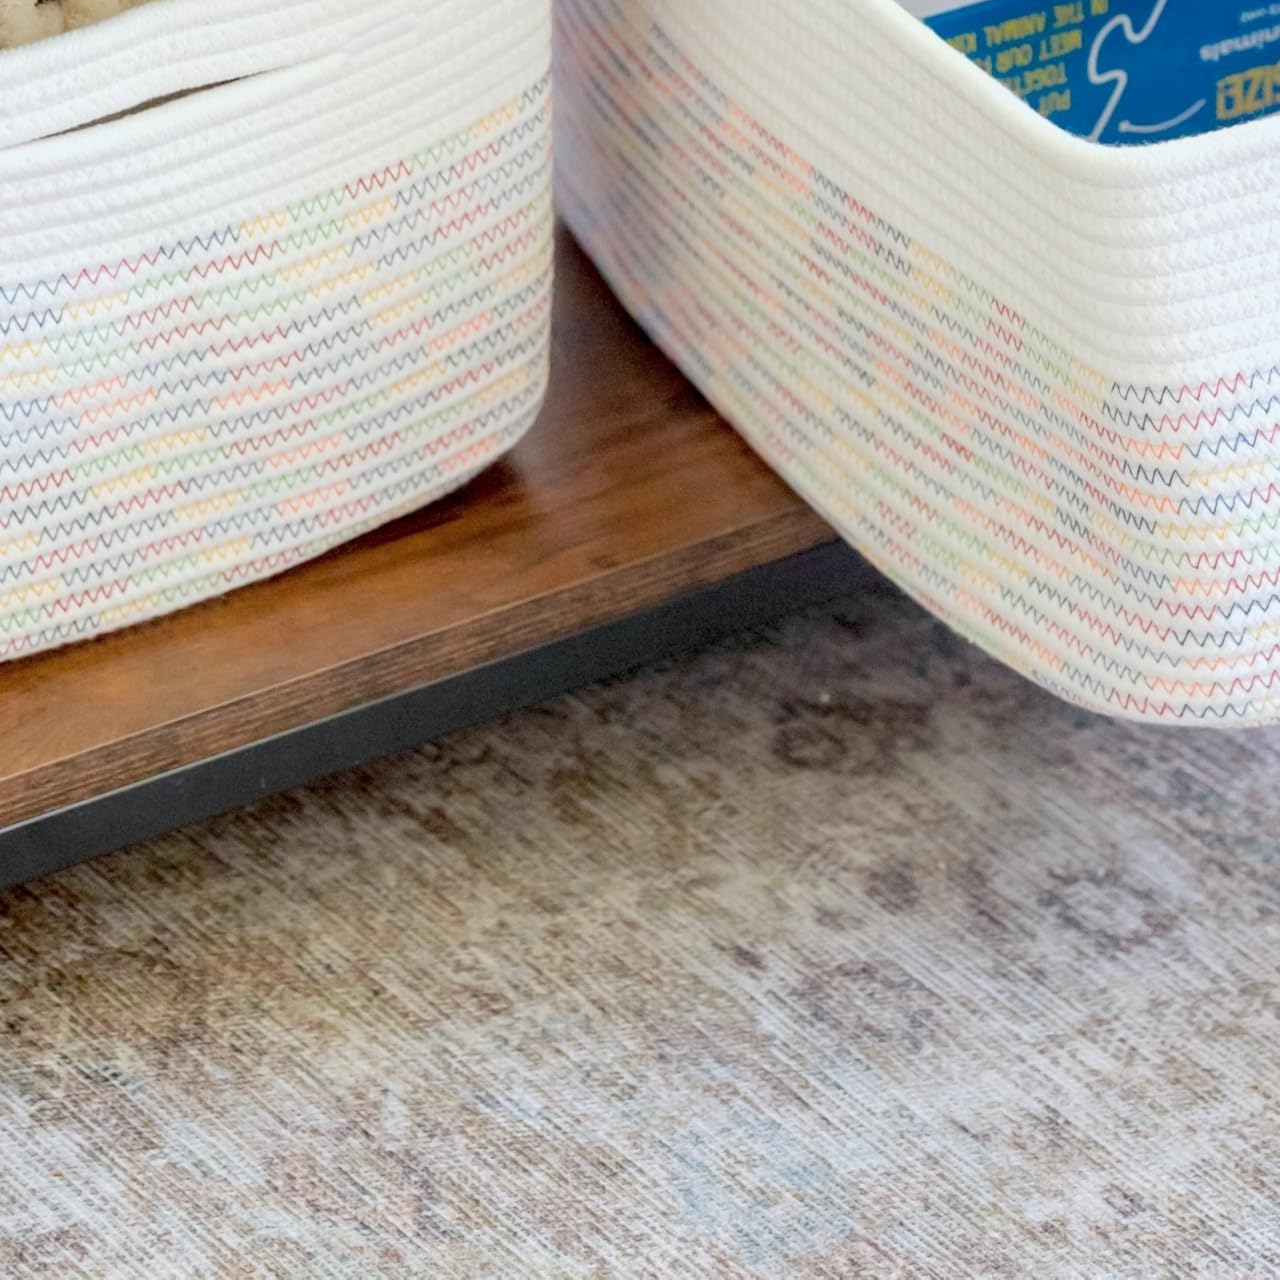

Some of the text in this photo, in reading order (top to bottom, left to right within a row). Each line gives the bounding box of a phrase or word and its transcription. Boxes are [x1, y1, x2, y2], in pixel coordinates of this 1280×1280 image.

[1053, 0, 1085, 28] THE
[983, 11, 1047, 47] ANIMAL
[996, 44, 1033, 73] OUR
[1039, 29, 1082, 61] MEET
[1039, 89, 1071, 117] PUT
